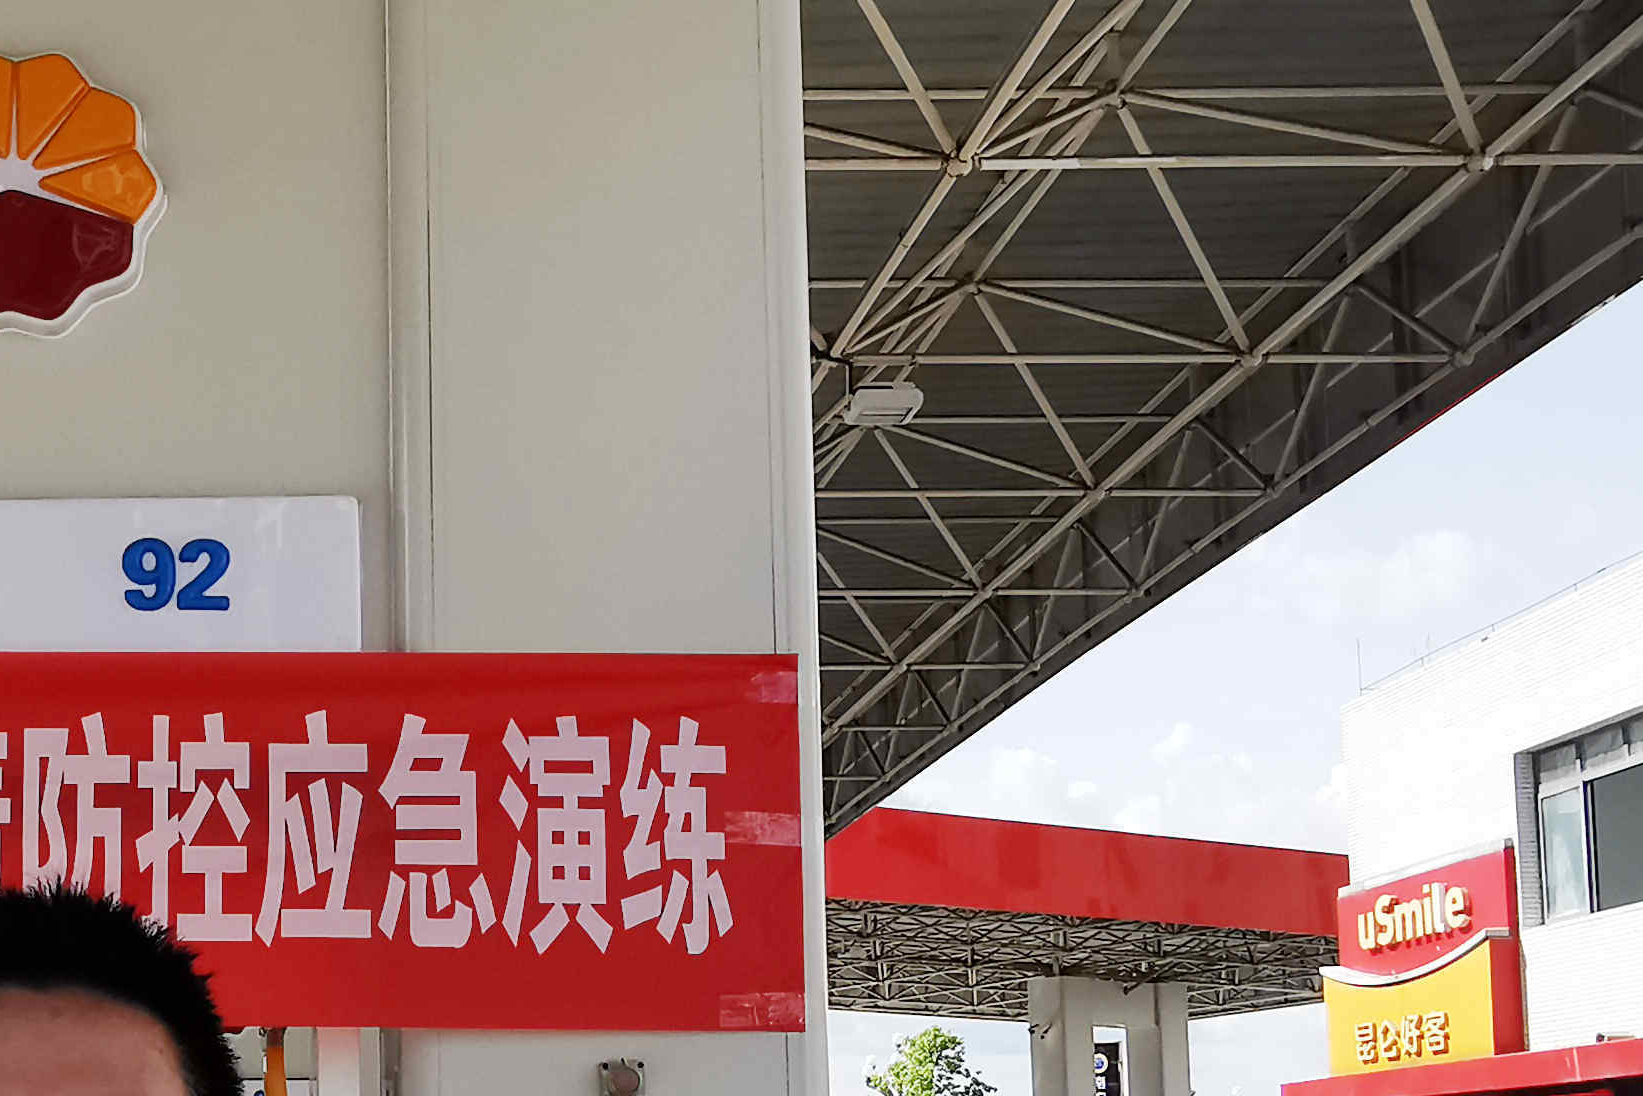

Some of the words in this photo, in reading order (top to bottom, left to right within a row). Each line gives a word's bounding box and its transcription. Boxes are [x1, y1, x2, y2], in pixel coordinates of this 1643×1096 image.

[122, 537, 231, 612] 92
[1357, 882, 1471, 950] uSmile
[1355, 1011, 1450, 1065] 昆仑好客
